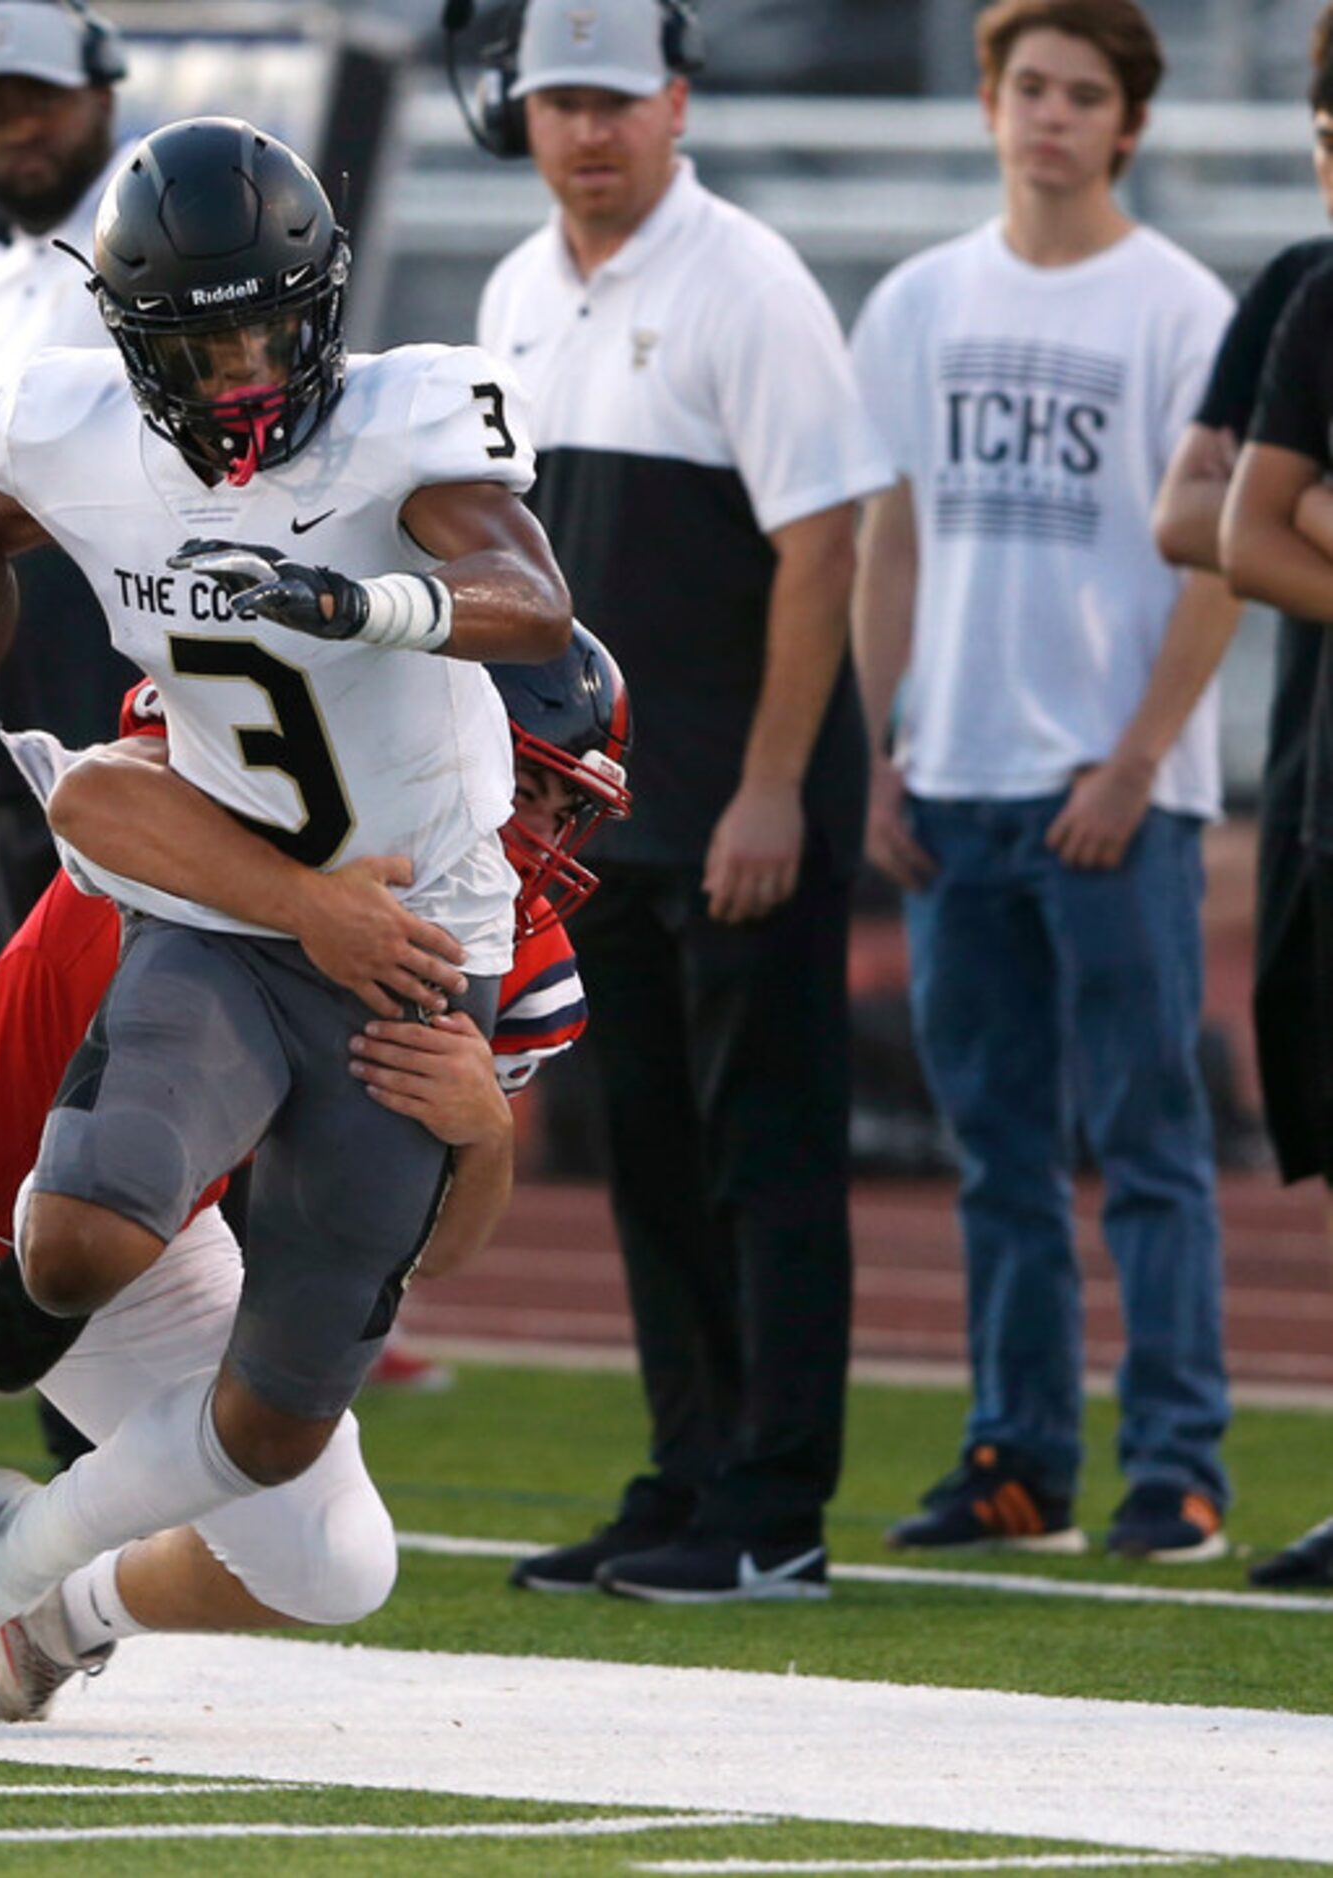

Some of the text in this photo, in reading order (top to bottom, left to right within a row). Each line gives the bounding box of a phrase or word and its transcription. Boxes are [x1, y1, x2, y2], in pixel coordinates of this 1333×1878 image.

[191, 278, 259, 306] Riddell
[470, 382, 517, 460] 3
[947, 390, 1107, 477] TCHS
[113, 567, 177, 617] THE
[165, 631, 359, 874] 3
